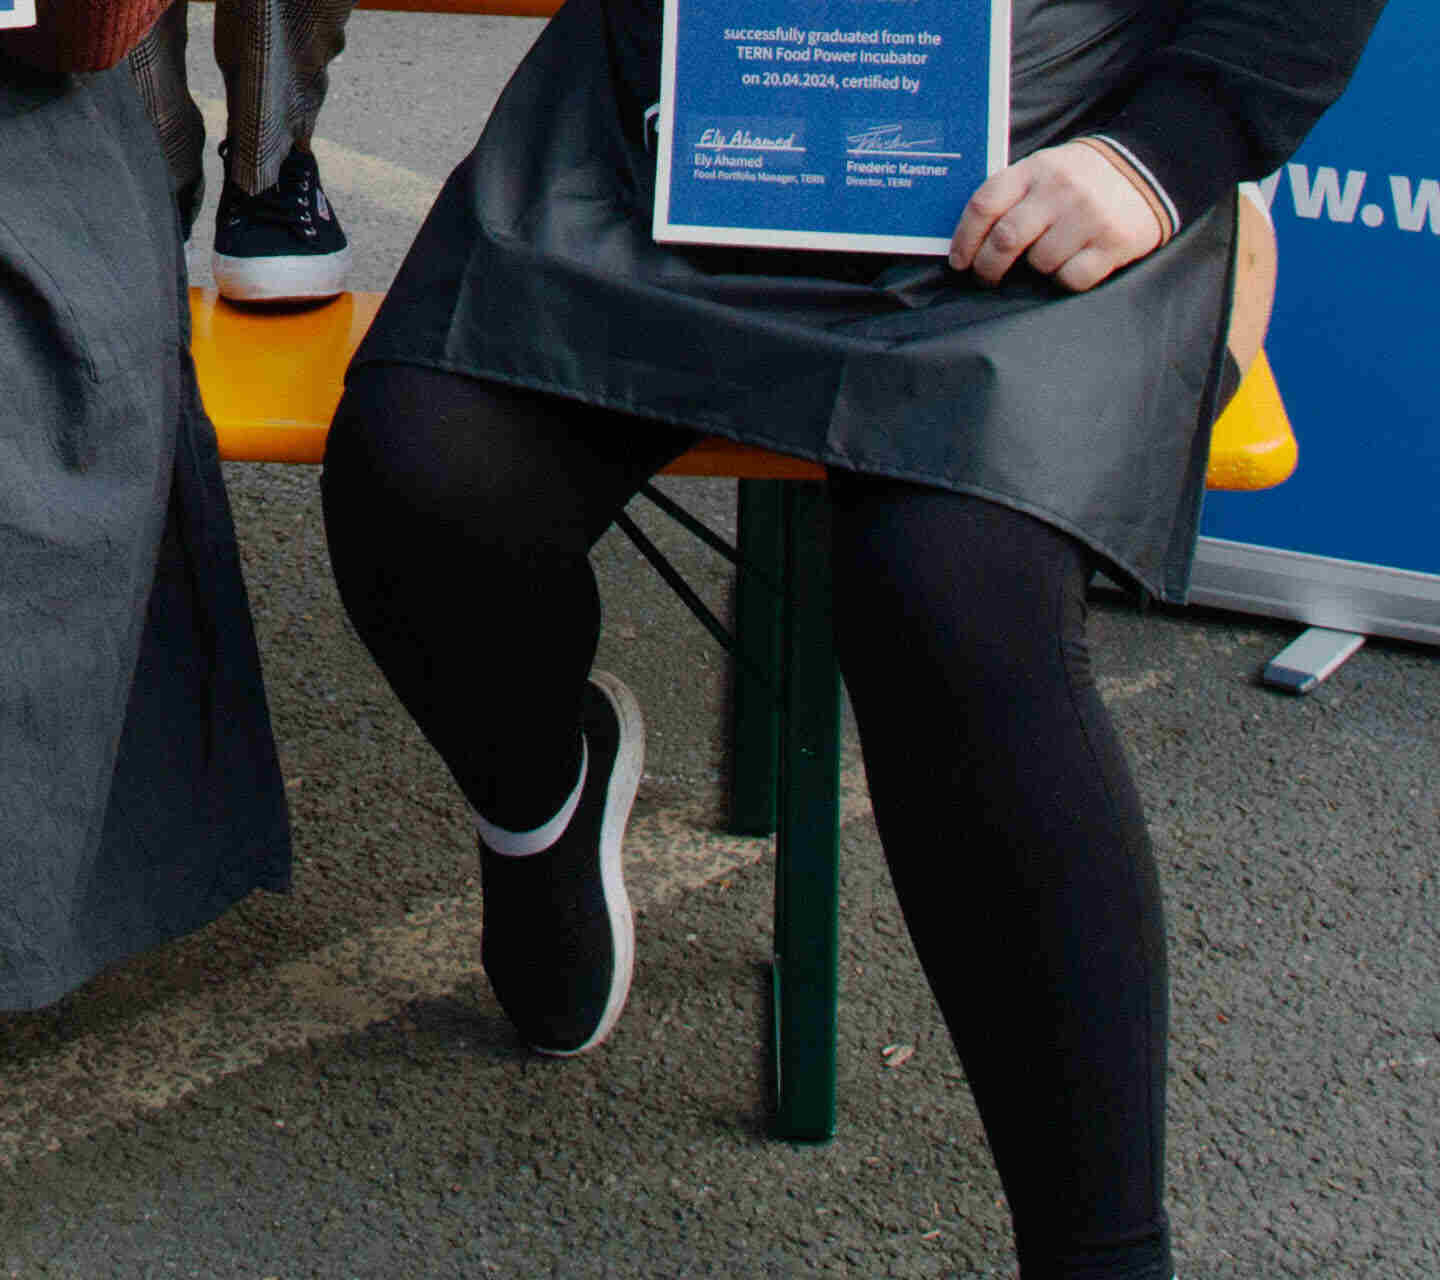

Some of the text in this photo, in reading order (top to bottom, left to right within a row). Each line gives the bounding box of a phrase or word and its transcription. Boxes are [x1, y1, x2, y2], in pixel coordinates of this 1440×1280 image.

[723, 26, 942, 46] successfully graduated from the
[735, 45, 928, 64] TERN Food Power Incubator
[741, 73, 760, 85] on
[841, 75, 900, 90] certified
[902, 75, 920, 92] by
